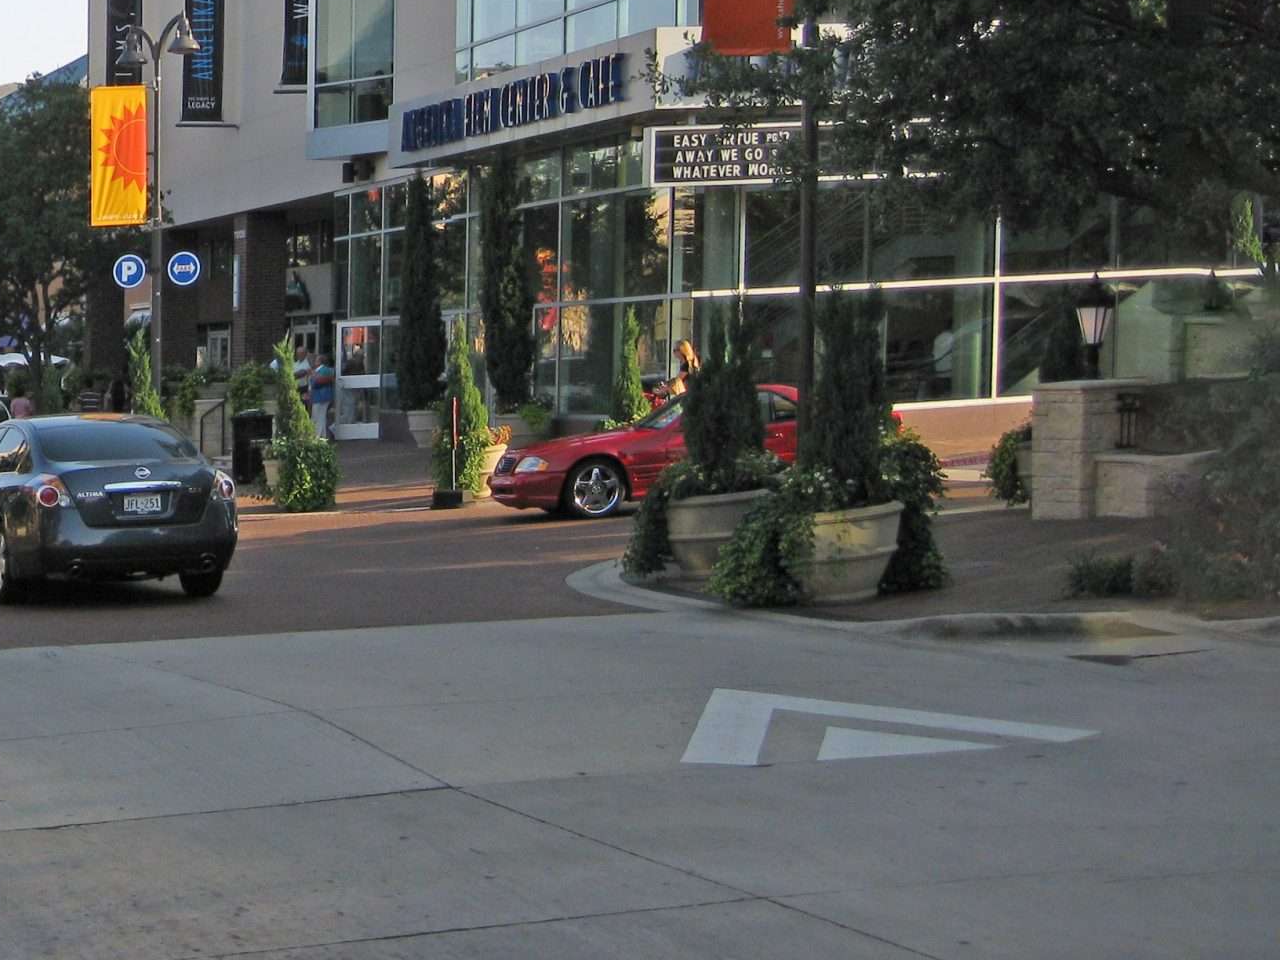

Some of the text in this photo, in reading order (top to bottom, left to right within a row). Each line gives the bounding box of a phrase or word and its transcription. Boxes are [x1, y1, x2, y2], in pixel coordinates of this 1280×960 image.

[463, 88, 493, 137] FILM
[499, 72, 553, 129] CENTER
[559, 68, 571, 114] &
[578, 53, 618, 109] CAFE
[673, 134, 707, 148] EASY
[675, 150, 713, 163] AWAY
[720, 148, 738, 161] WE
[745, 148, 763, 161] GO
[672, 165, 741, 179] WHATEVER
[121, 261, 138, 282] P
